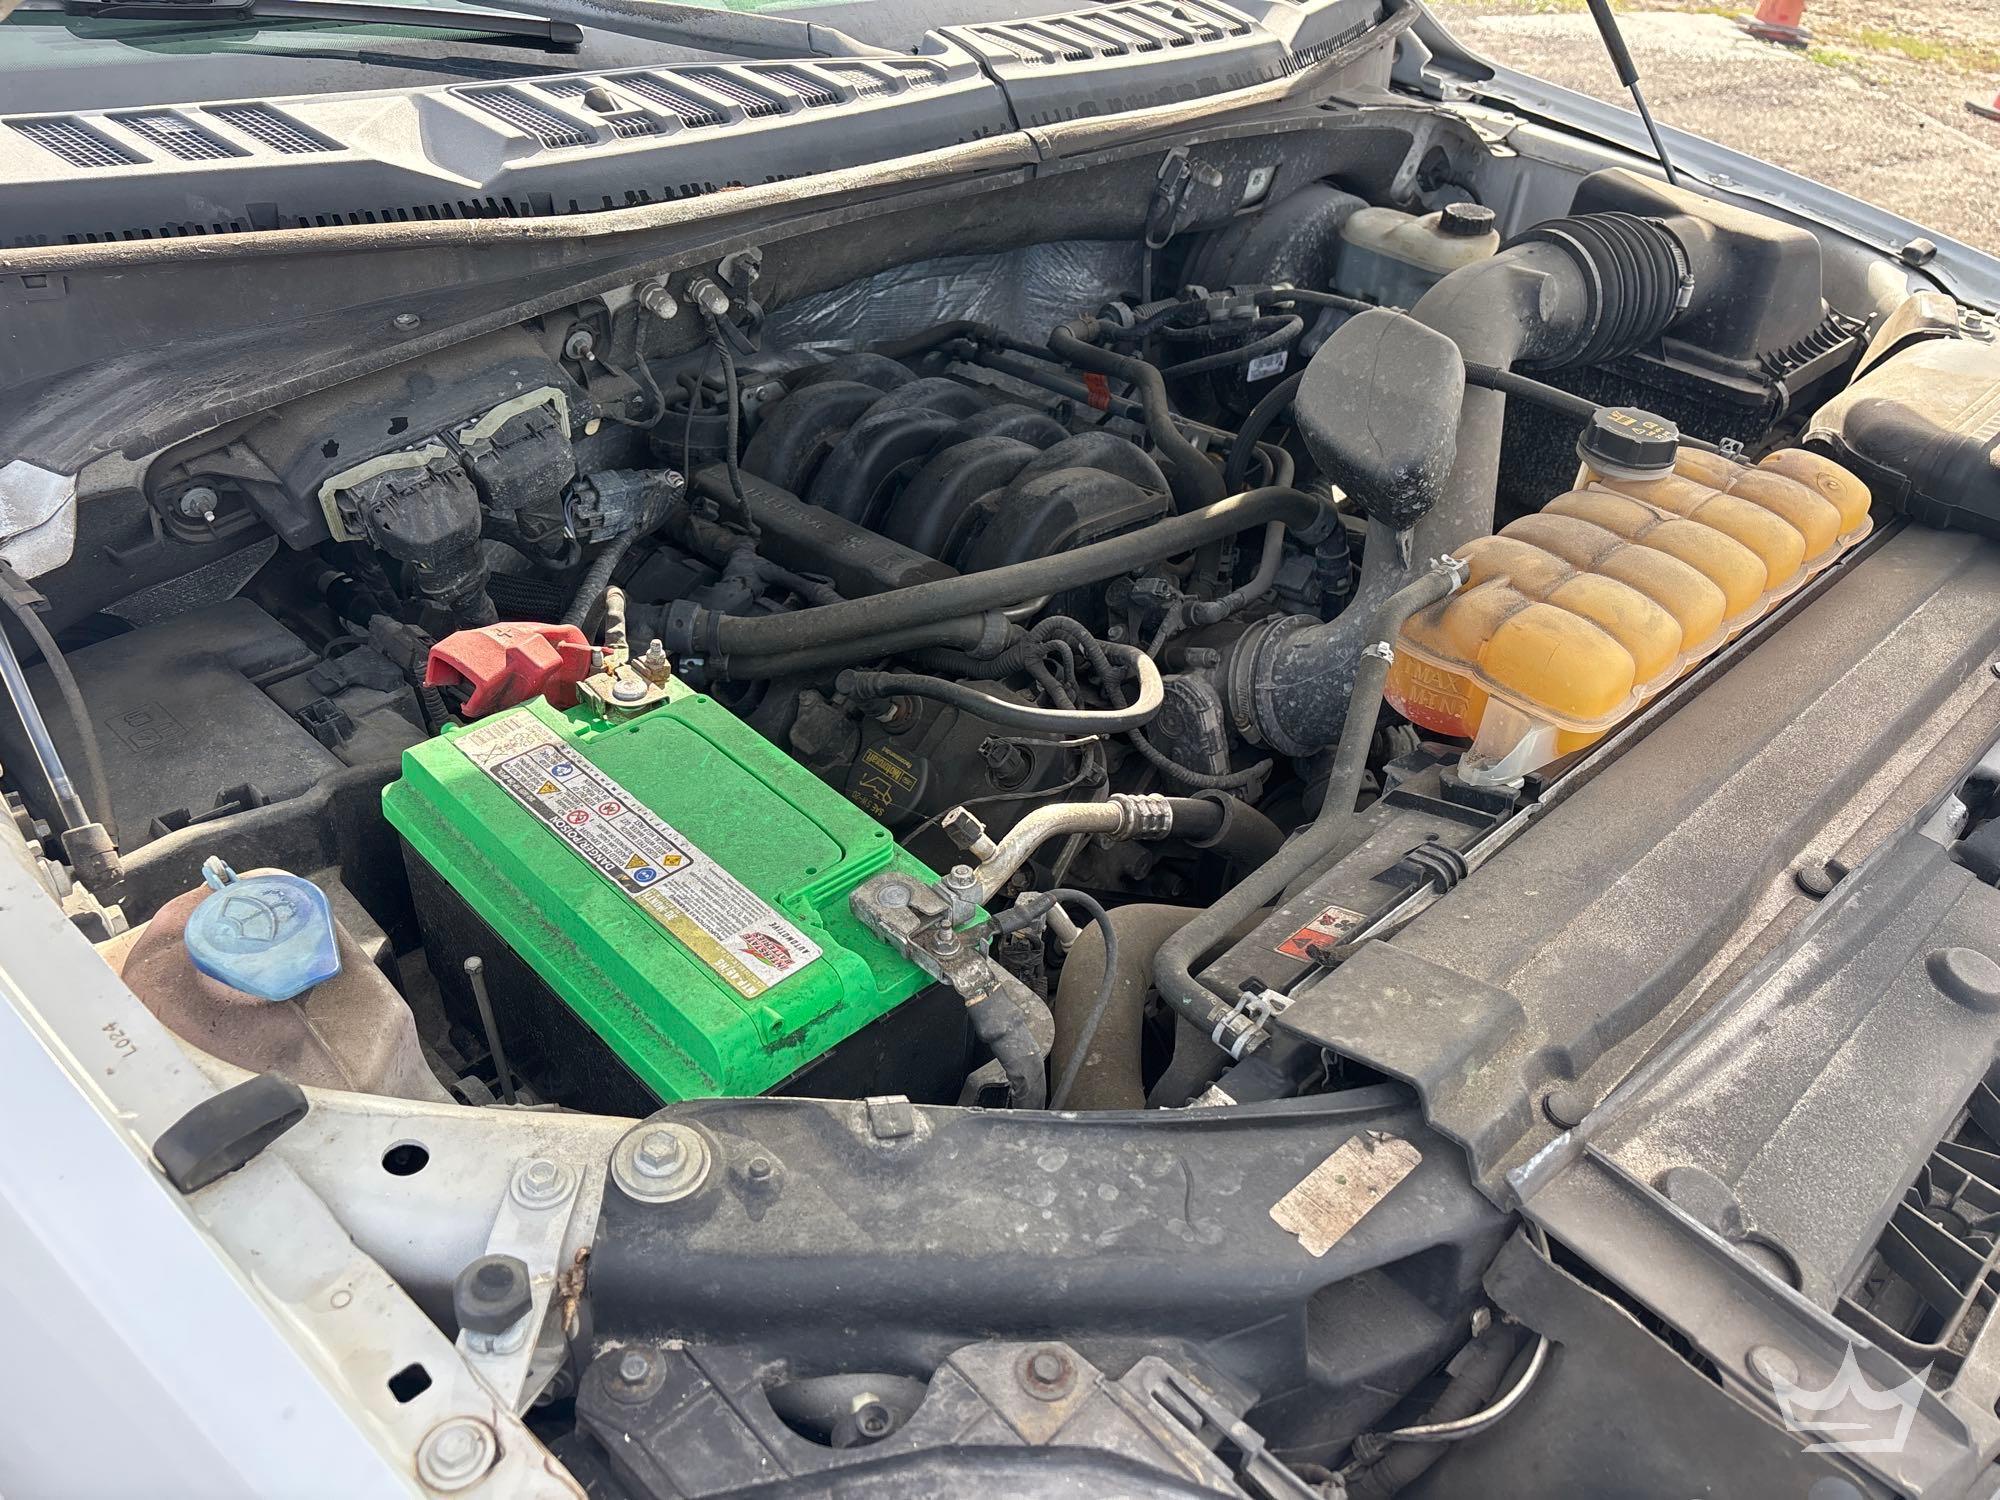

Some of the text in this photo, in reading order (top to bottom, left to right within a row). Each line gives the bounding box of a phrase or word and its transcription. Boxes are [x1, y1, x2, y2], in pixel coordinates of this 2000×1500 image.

[1413, 666, 1461, 692] MAX
[1411, 686, 1457, 714] MIN
[864, 751, 903, 780] Motorcraft
[548, 815, 615, 870] DANGER/POISON
[741, 932, 788, 970] INTERSTATE
[752, 931, 793, 965] BATTERIES
[767, 921, 810, 955] AUTOMOTIVE
[102, 1022, 136, 1058] L024
